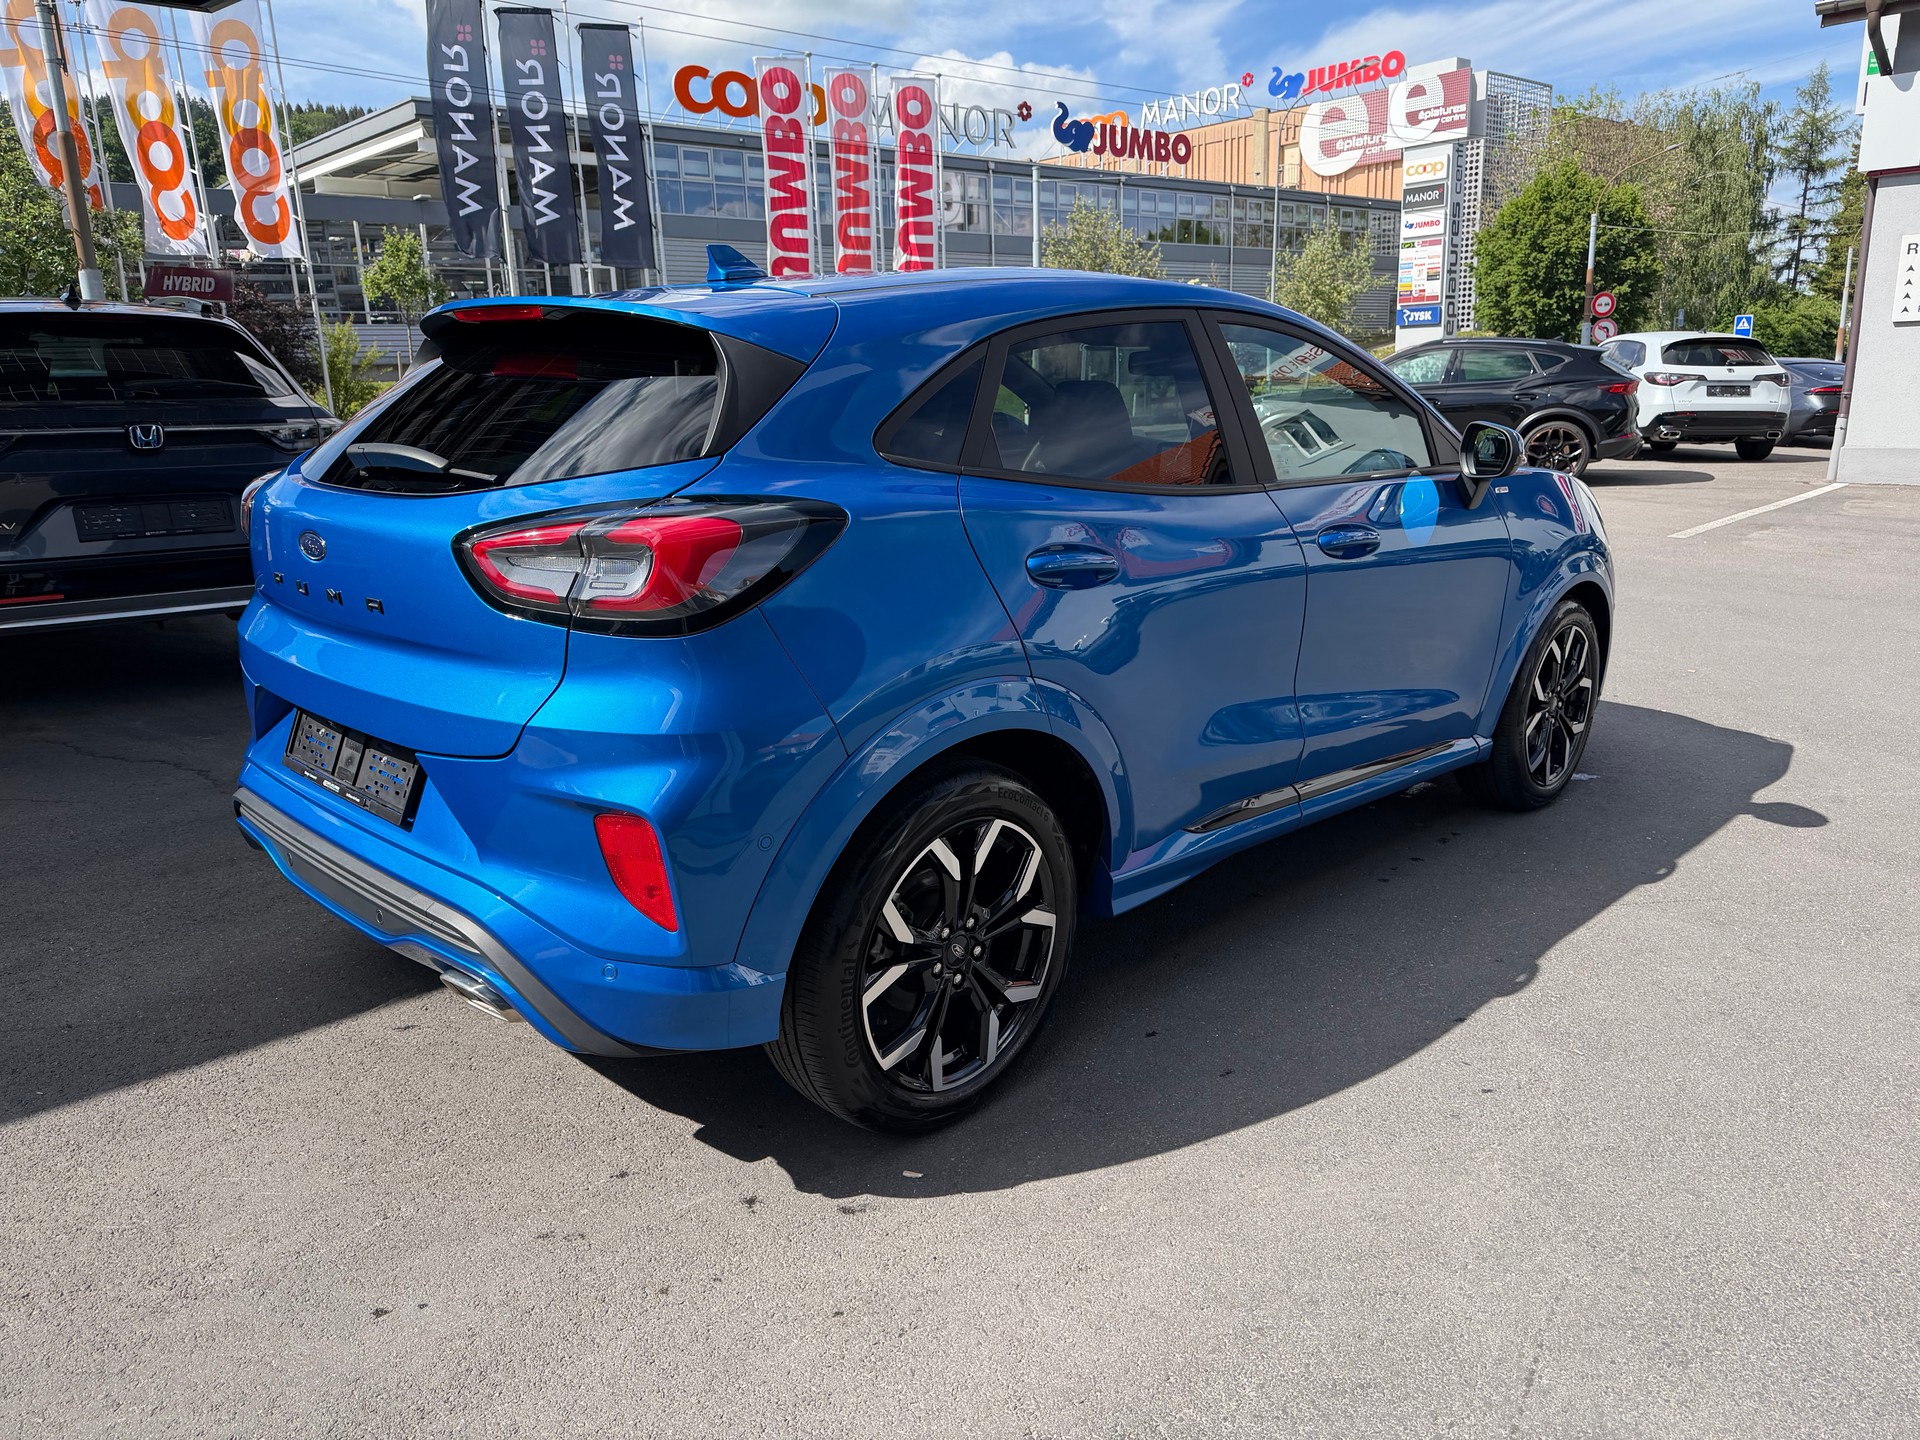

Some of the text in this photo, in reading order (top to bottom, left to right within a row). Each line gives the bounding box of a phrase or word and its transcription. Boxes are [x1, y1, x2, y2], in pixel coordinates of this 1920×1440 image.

[1301, 50, 1406, 96] JUMBO
[1140, 82, 1241, 128] MANOR
[1418, 103, 1467, 121] éplatures
[1440, 113, 1466, 123] centre
[1092, 123, 1192, 165] JUMBO
[1405, 161, 1445, 177] coop
[1455, 138, 1464, 195] centr
[1405, 190, 1440, 204] MANOR
[1414, 219, 1441, 229] JUMBO
[162, 274, 216, 294] HYBRID
[1409, 310, 1432, 321] JYSK
[272, 570, 385, 616] PUMA
[837, 957, 861, 1068] Continental
